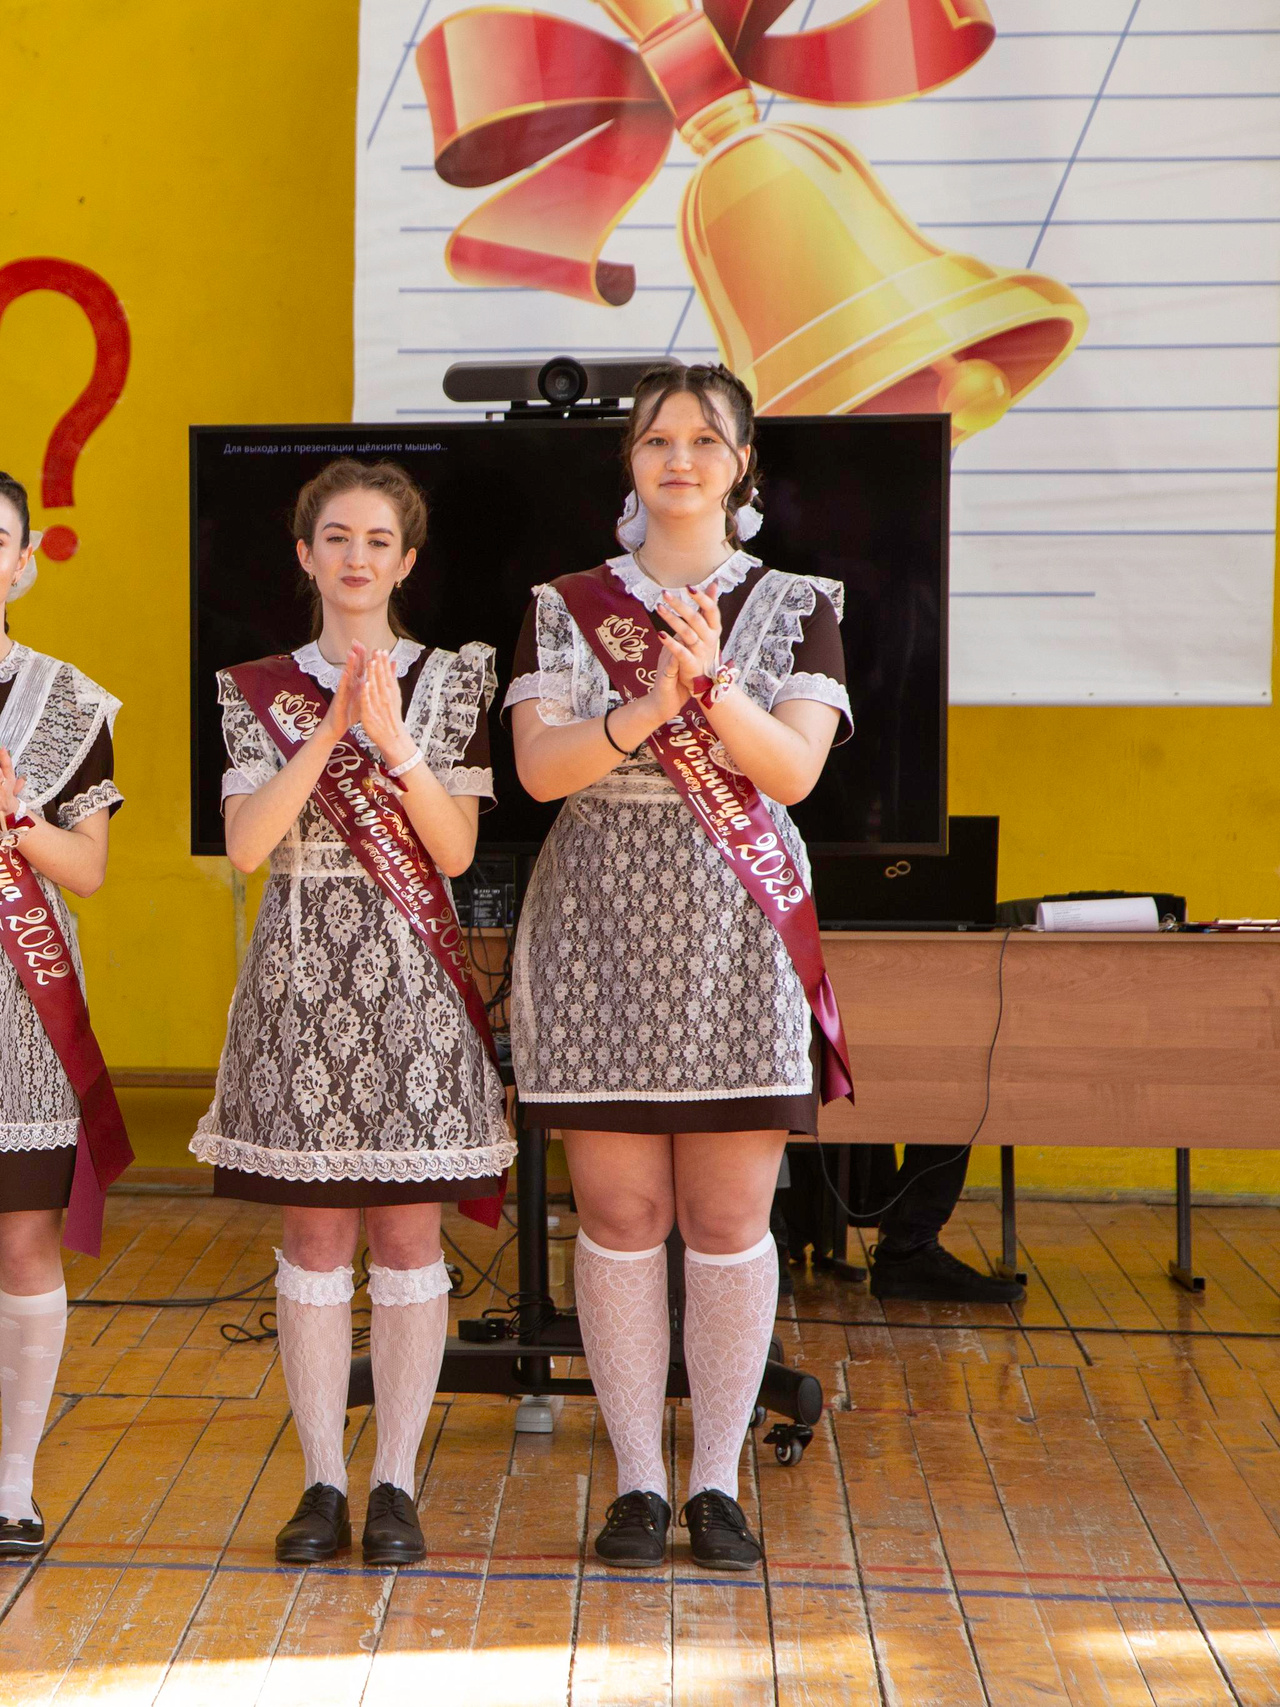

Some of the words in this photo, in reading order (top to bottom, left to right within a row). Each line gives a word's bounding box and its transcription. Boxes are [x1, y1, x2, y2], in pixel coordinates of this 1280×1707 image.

[223, 443, 242, 455] Для
[244, 444, 279, 455] выхода
[280, 445, 292, 453] из
[294, 443, 354, 454] презентации
[356, 442, 403, 453] щёлкните
[325, 741, 435, 905] Выпускница
[326, 791, 338, 801] 11
[736, 832, 804, 912] 2022
[5, 906, 69, 986] 2022
